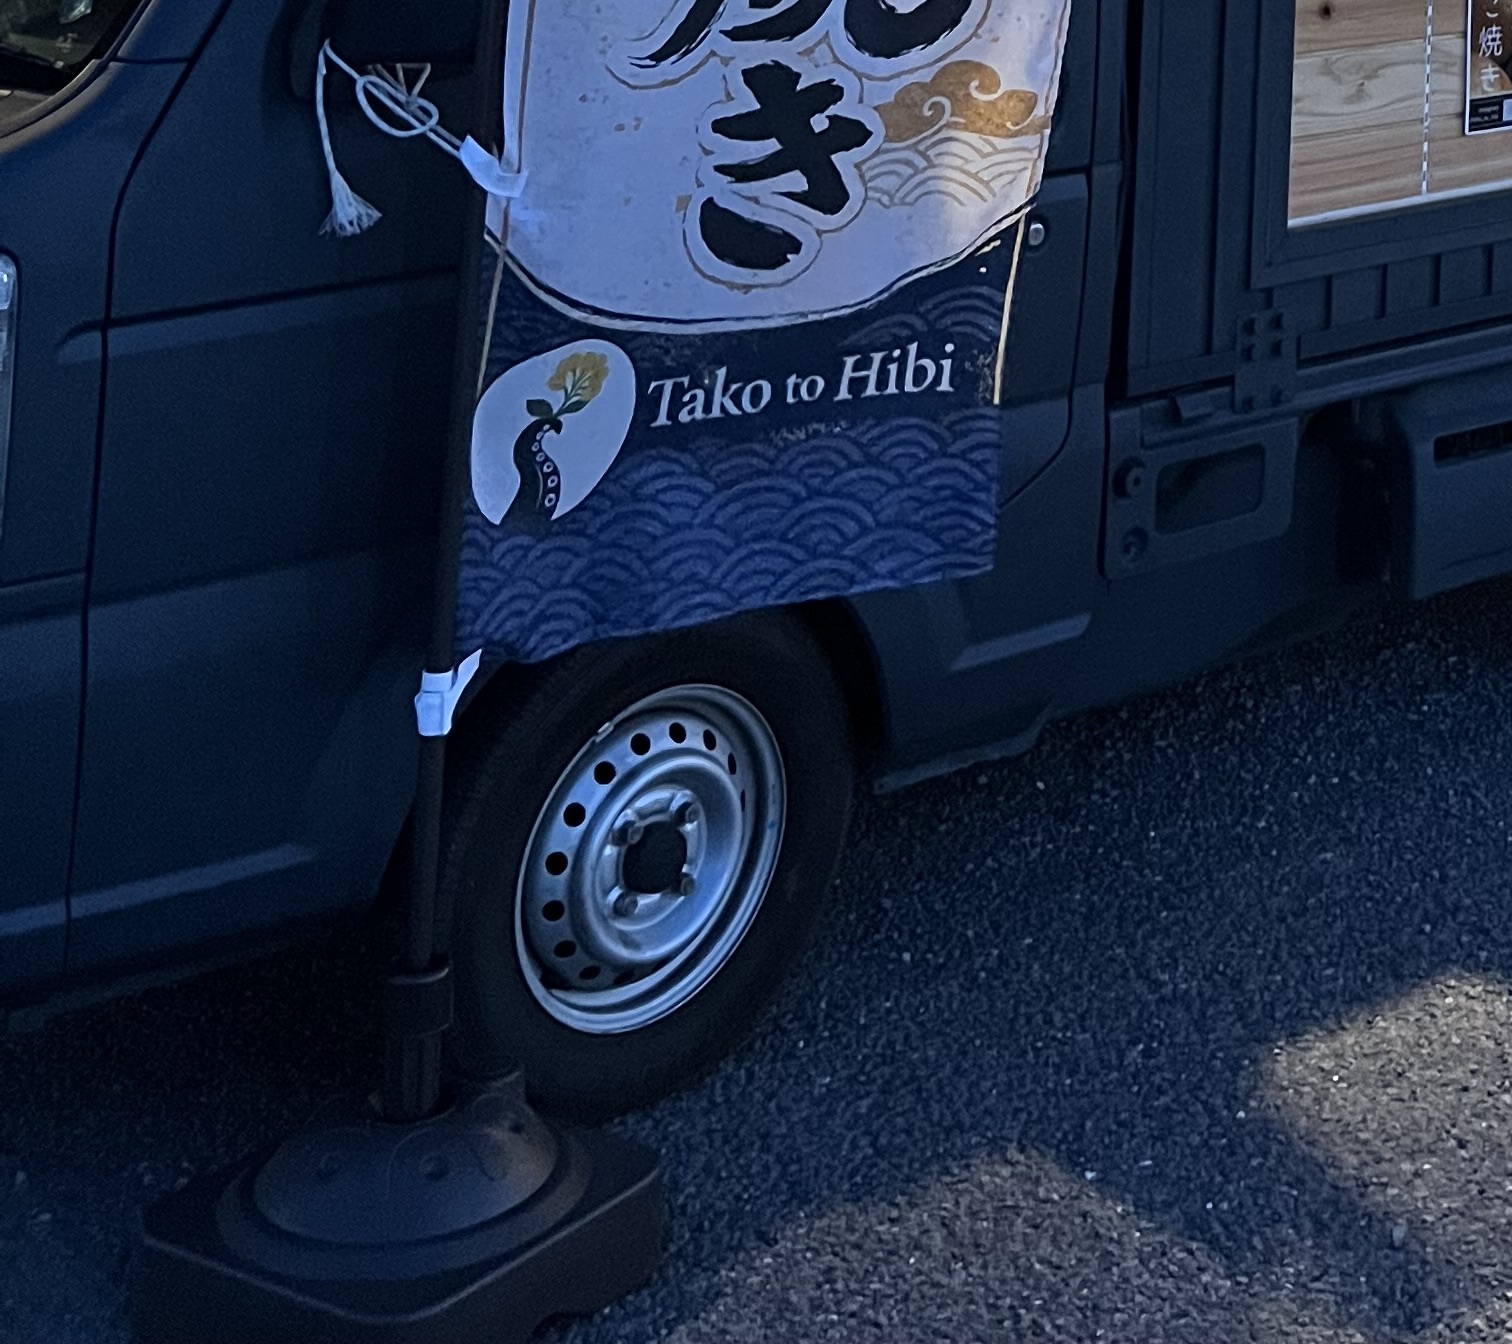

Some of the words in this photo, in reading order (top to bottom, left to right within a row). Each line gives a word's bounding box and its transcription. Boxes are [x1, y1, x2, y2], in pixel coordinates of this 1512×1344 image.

[648, 365, 772, 428] Tako
[785, 372, 825, 404] to
[834, 341, 955, 402] Hibi
